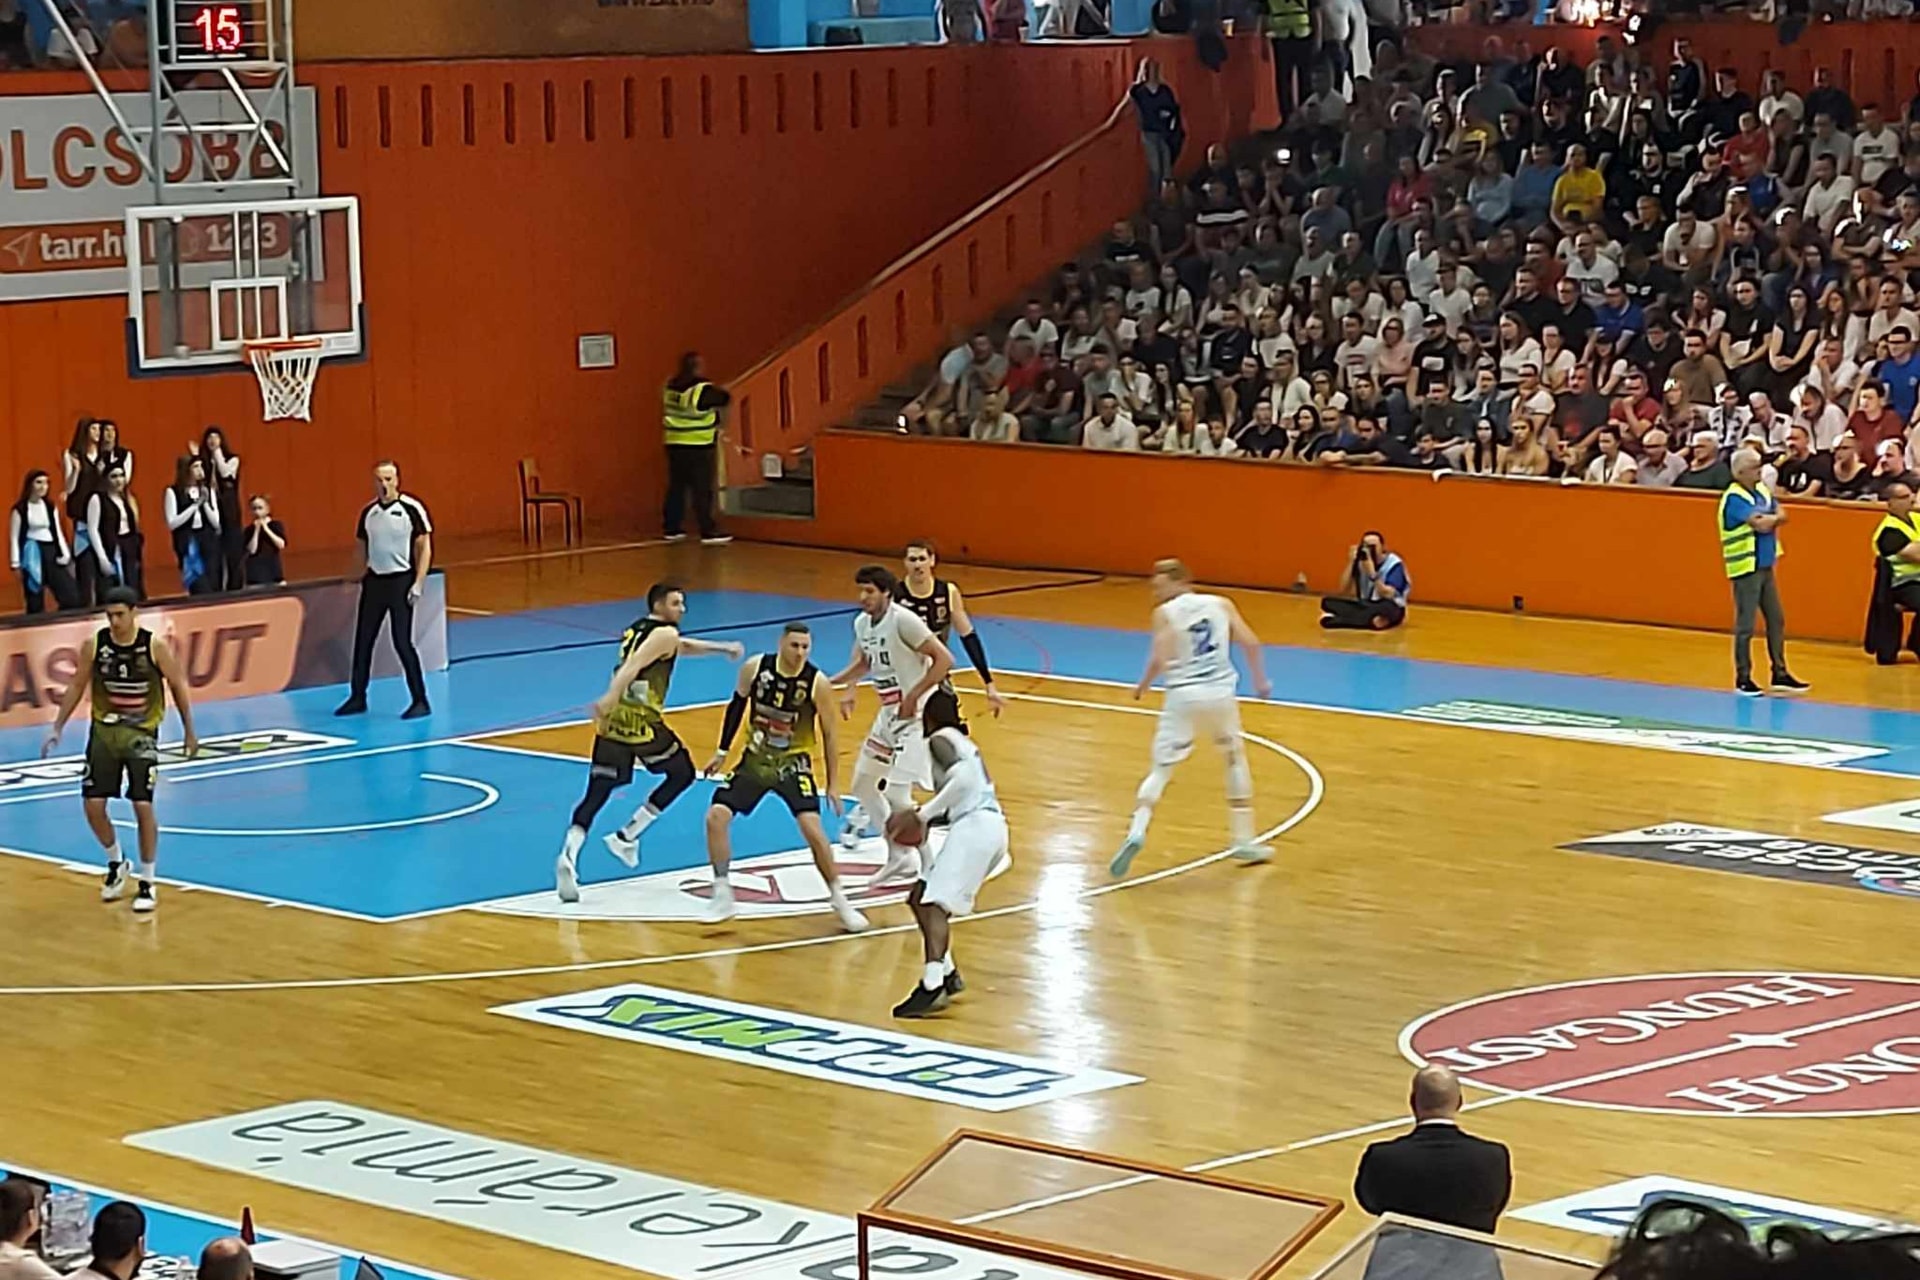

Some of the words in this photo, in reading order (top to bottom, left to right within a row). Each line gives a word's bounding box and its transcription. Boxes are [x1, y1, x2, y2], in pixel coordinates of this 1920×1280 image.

[195, 7, 241, 51] 15
[0, 104, 288, 190] LCSÓBB
[40, 227, 128, 262] tarr.h
